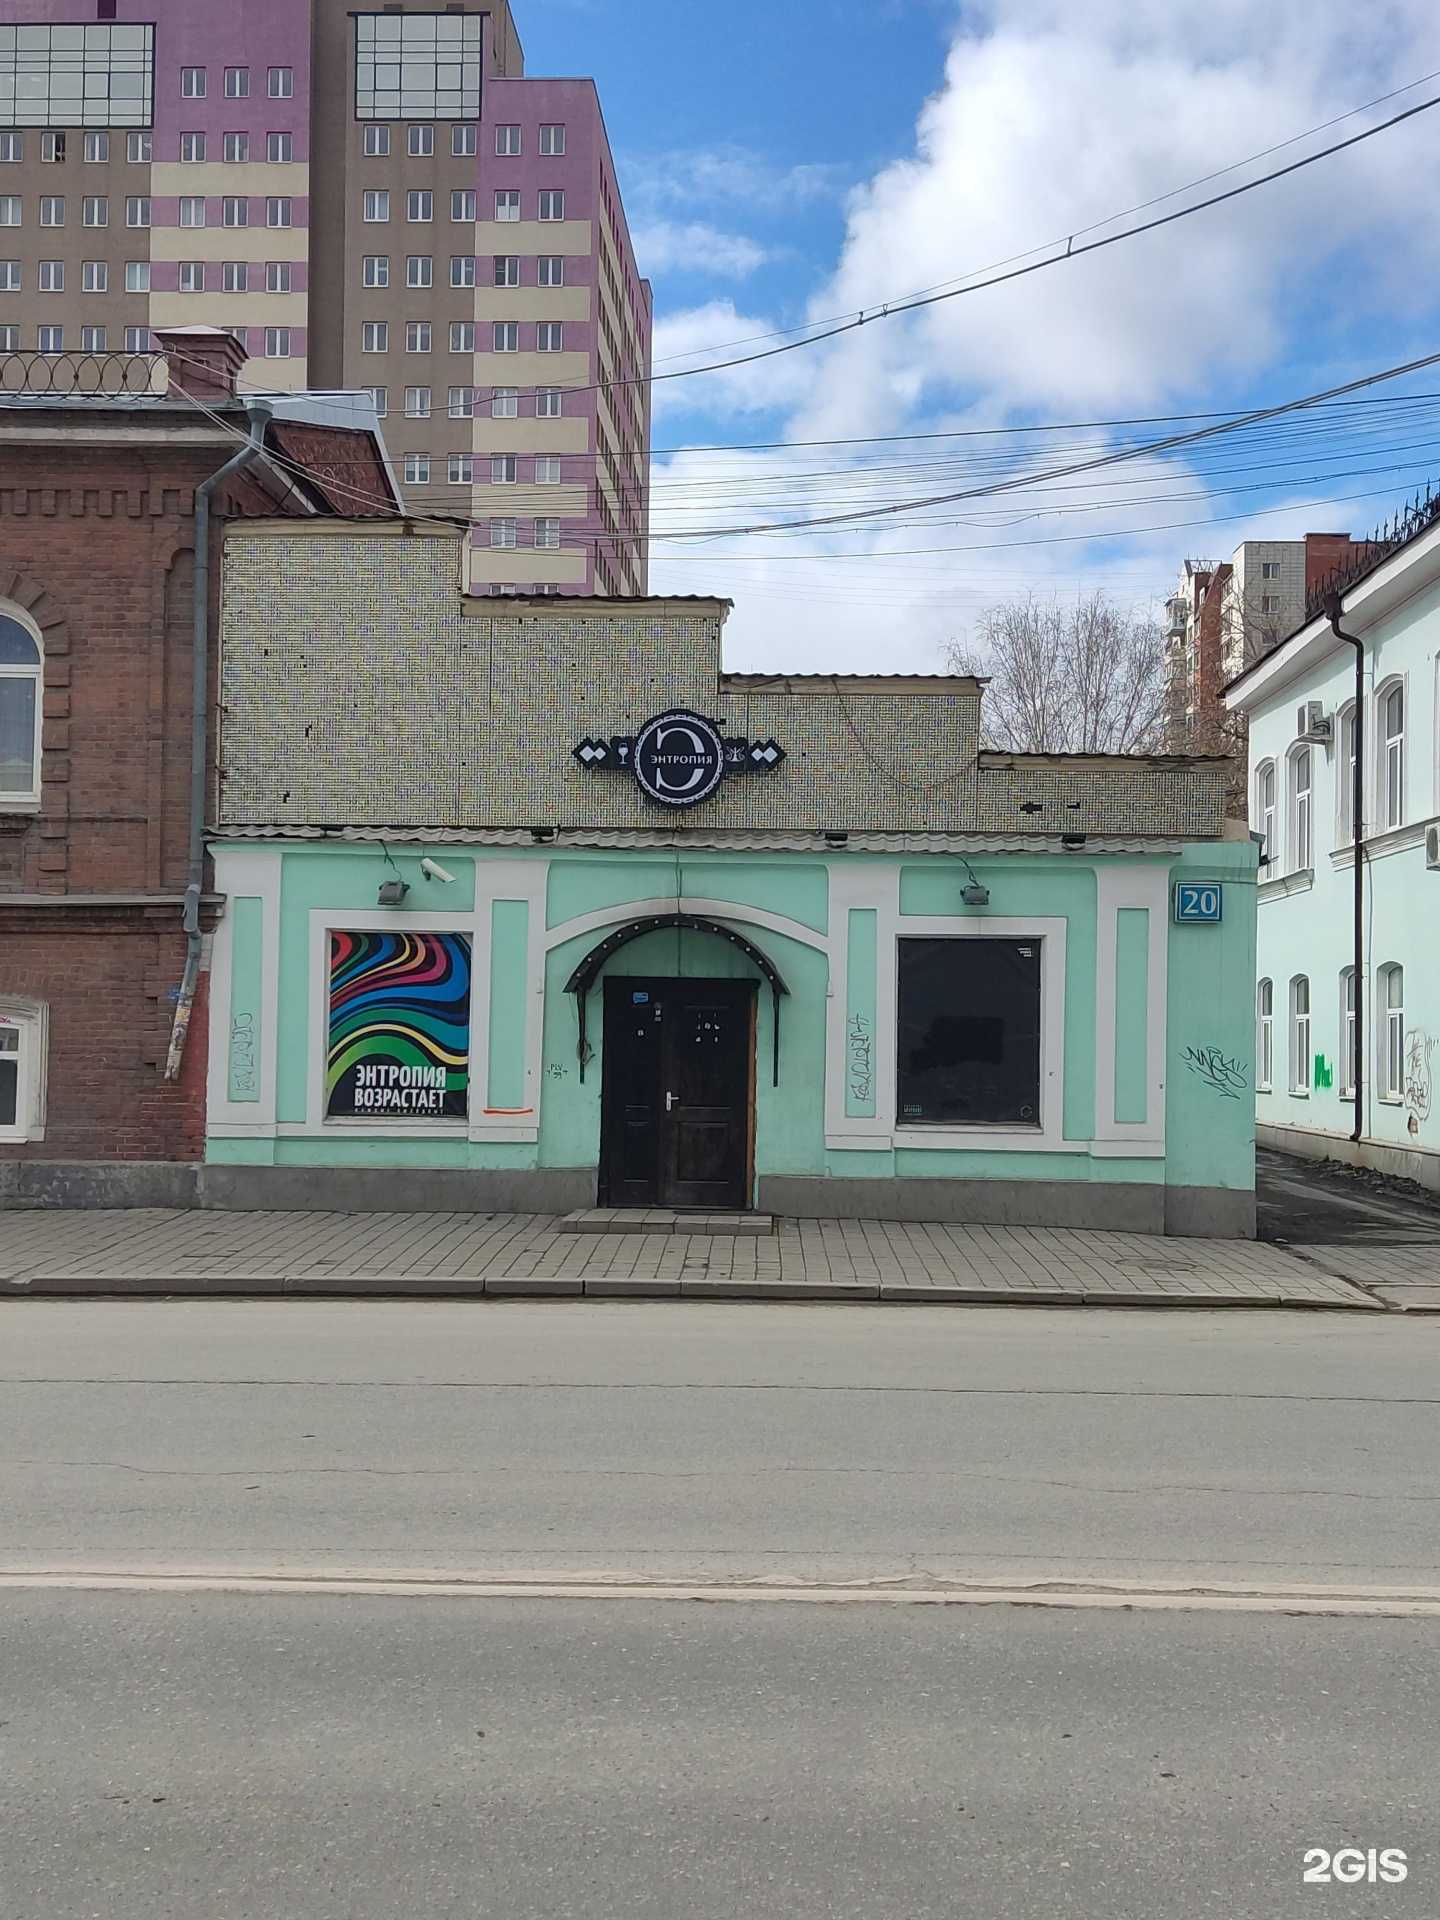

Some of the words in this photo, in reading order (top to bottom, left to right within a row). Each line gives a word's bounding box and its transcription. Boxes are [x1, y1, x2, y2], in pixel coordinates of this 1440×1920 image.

[650, 754, 713, 765] ЭНТРОПИЯ
[1183, 890, 1217, 914] 20
[355, 1065, 446, 1088] ЭНТРОПИЯ
[354, 1088, 447, 1108] ВОЗРАСТАЕТ
